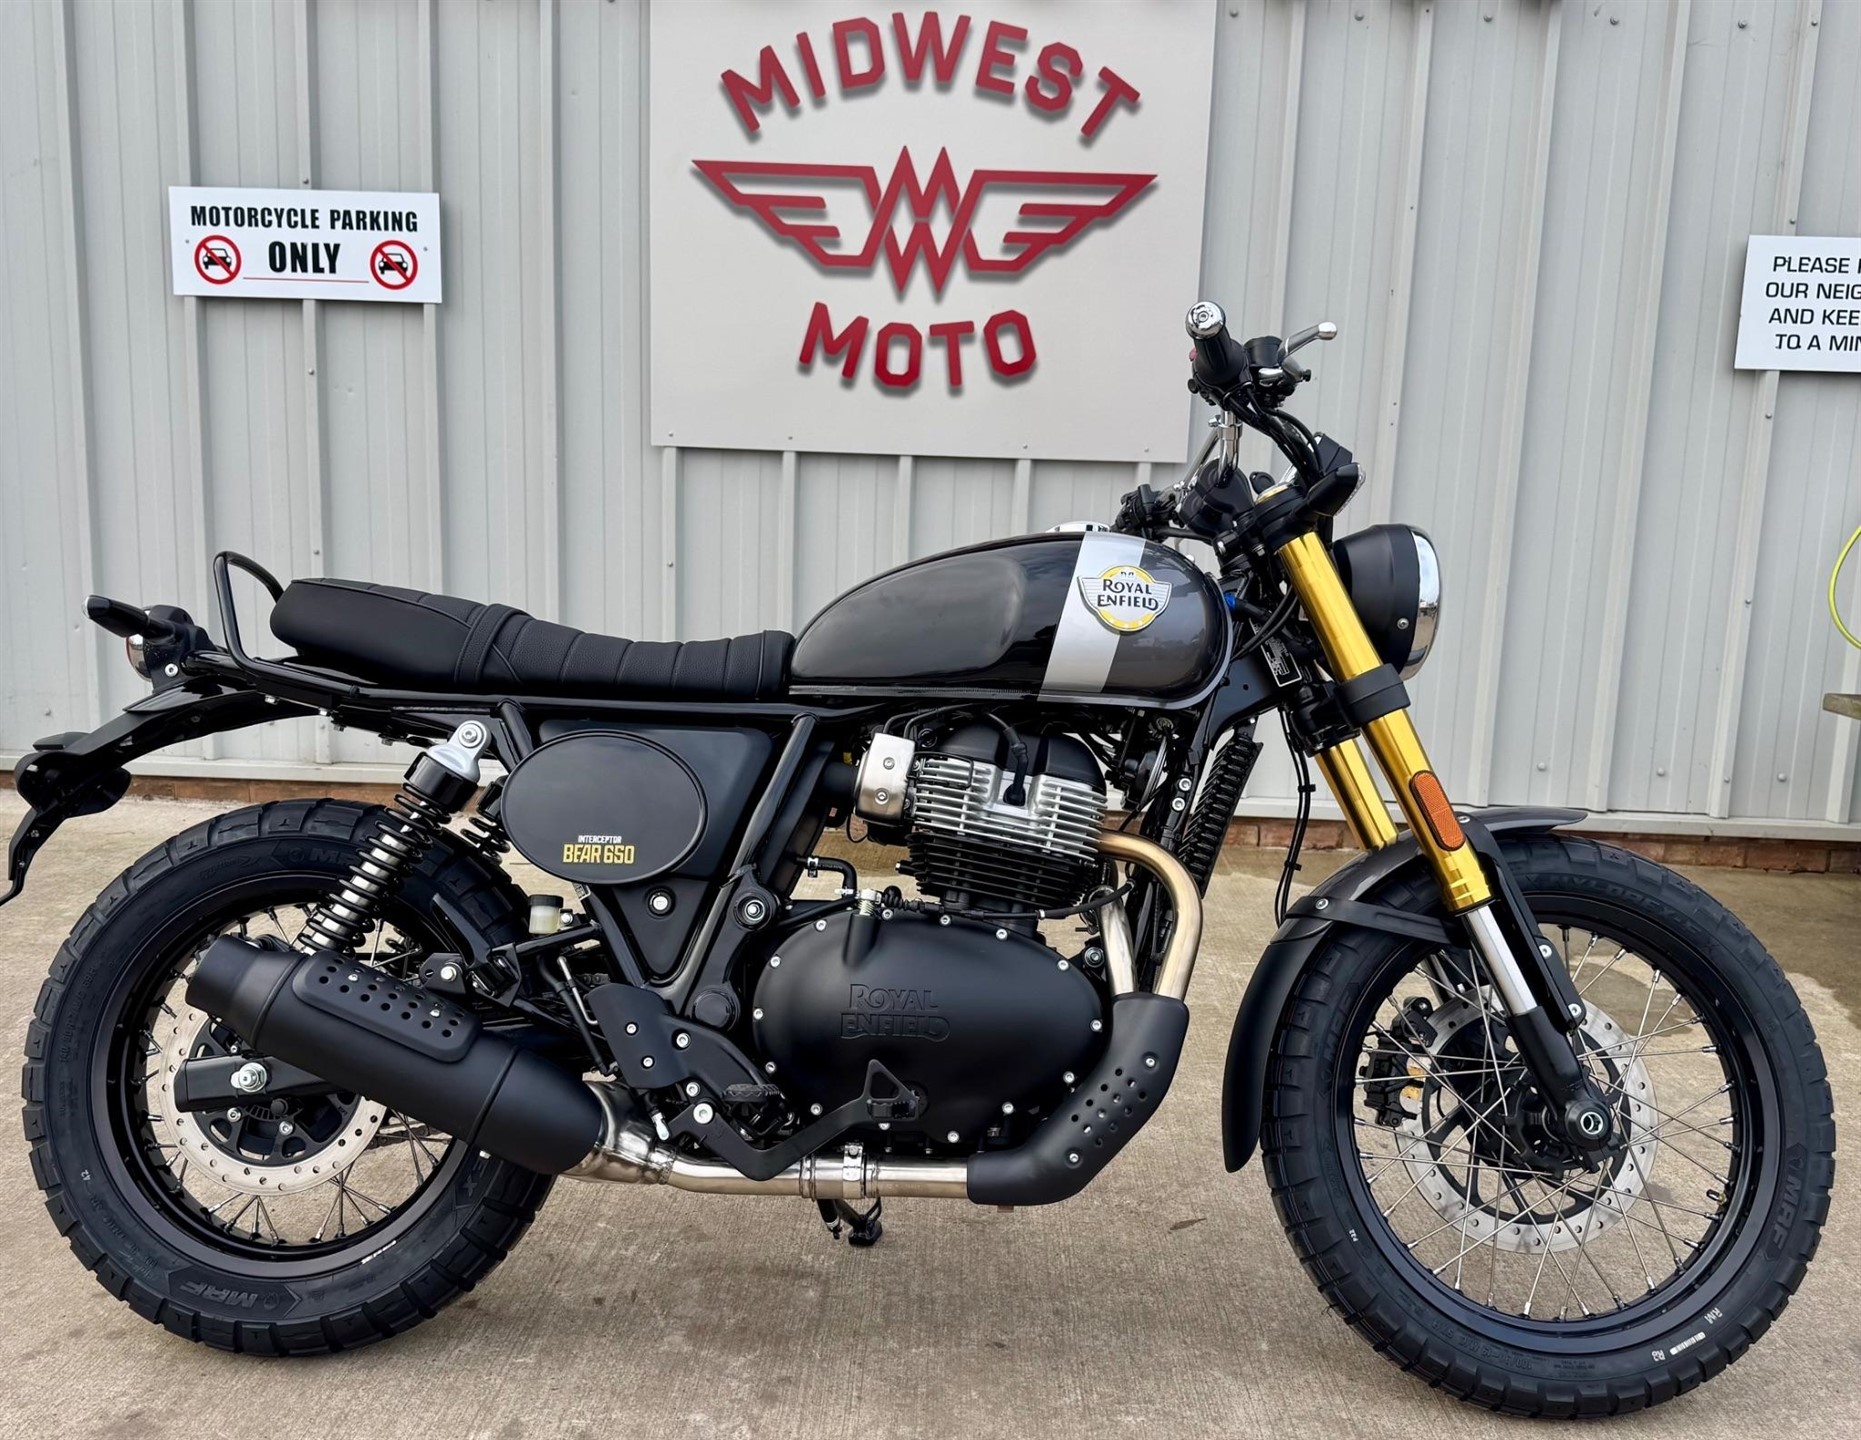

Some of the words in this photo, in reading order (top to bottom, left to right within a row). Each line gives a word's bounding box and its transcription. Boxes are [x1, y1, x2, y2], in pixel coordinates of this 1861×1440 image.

[720, 11, 1140, 138] MIDWEST
[190, 205, 319, 229] MOTORCYCLE
[330, 209, 418, 233] PARKING
[268, 240, 341, 274] ONLY
[1773, 256, 1850, 274] PLEASE
[1765, 281, 1809, 299] OUR
[1768, 308, 1815, 325] AND
[1822, 309, 1861, 326] KEE
[799, 301, 1037, 389] MOTO
[1775, 333, 1801, 350] TO
[1807, 334, 1821, 351] A
[1102, 579, 1153, 595] ROYAL
[1097, 594, 1159, 611] ENFIELD
[577, 834, 622, 844] INTERCEPTOR
[562, 843, 602, 863] BEAR
[603, 844, 635, 864] 650
[848, 983, 939, 1012] ROYAL
[840, 1012, 950, 1043] ENFIELD
[1774, 1175, 1802, 1251] MRF
[180, 1281, 258, 1308] MRF
